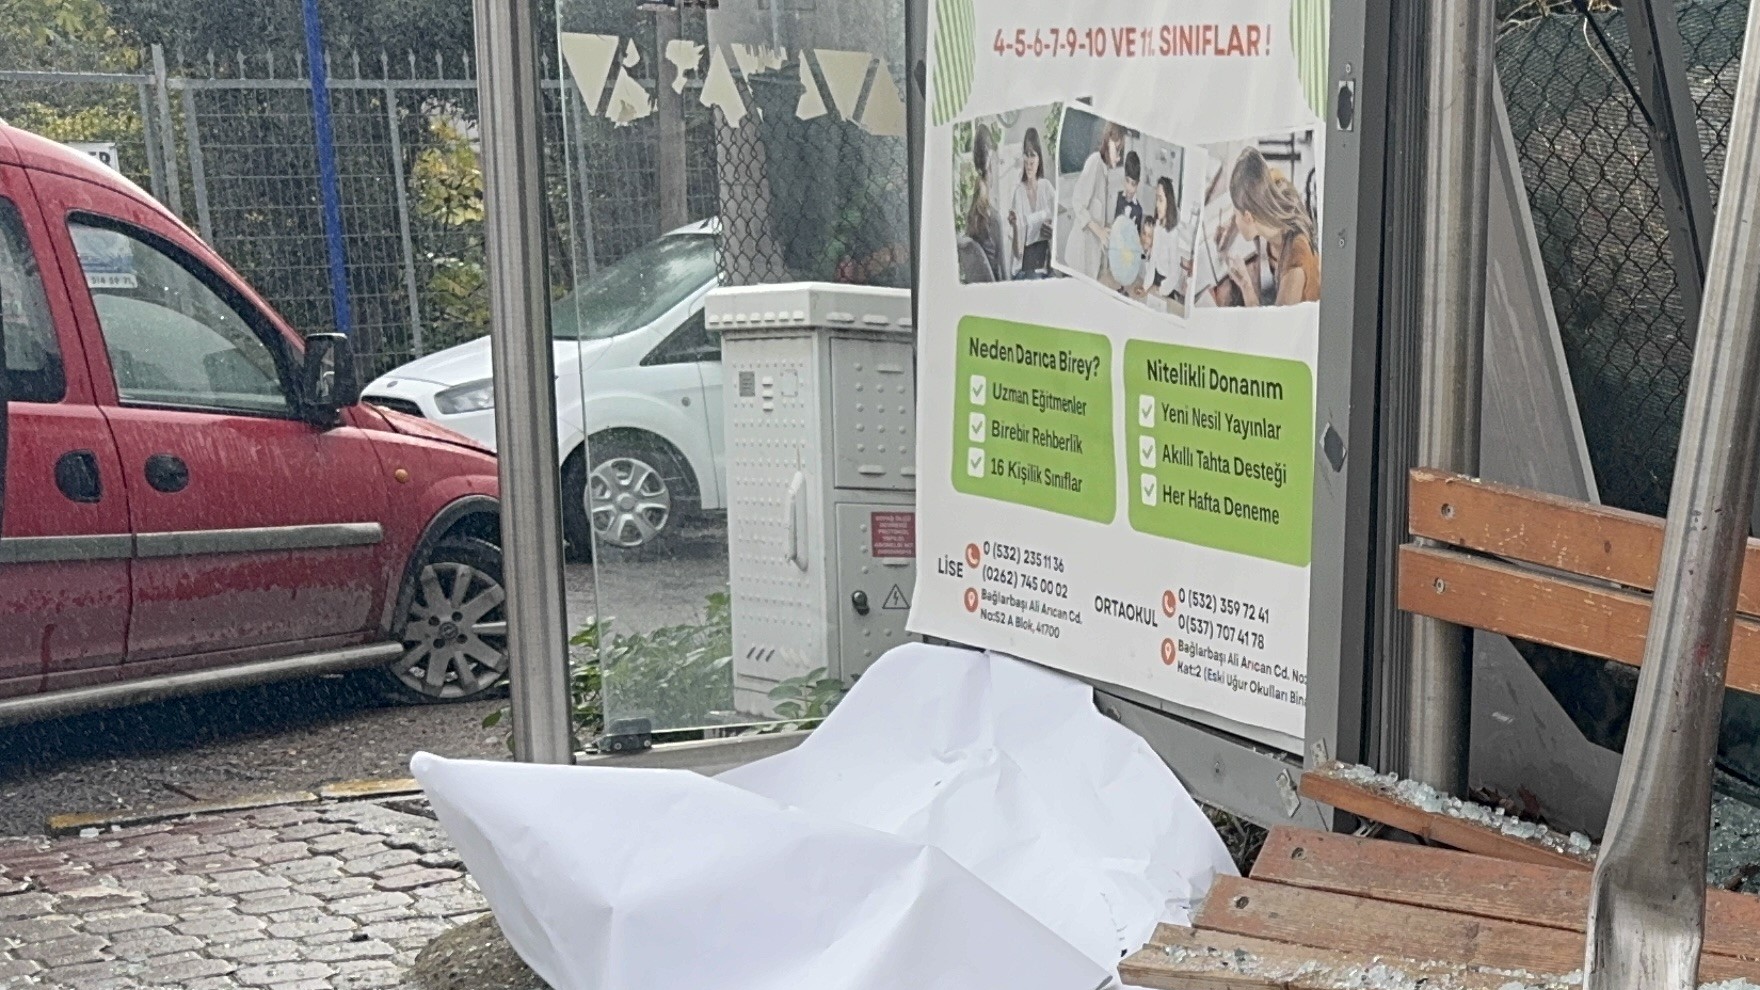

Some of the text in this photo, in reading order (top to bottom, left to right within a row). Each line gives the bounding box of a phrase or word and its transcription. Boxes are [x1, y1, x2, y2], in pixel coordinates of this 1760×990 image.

[993, 27, 1107, 57] 4-5-6-7-9-10
[1111, 27, 1136, 57] VE
[1141, 27, 1156, 57] 11.
[969, 337, 1100, 381] Neden Darıca Birey?
[1147, 359, 1283, 400] Nitelikli Donanım
[992, 382, 1087, 417] Uzman Eğitmenler
[991, 420, 1083, 455] Birebir Rehberlik
[1161, 402, 1282, 440] Yeni Nesil Yayınlar
[991, 457, 1082, 493] 16 Kişilik Sınıflar
[1162, 444, 1287, 488] Akıllı Tahta Desteği
[1163, 484, 1280, 525] Her Hafta Deneme
[938, 554, 964, 579] LİSE
[983, 541, 990, 555] 0
[993, 542, 1020, 565] (532)
[1024, 549, 1042, 567] 235
[1053, 556, 1064, 573] 36
[982, 564, 1068, 599] (0262) 745 00 02
[981, 588, 1027, 613] Bağlarbaşı
[1029, 599, 1040, 613] Ali
[1069, 610, 1083, 625] Cd.
[1007, 614, 1014, 627] A
[1094, 595, 1158, 628] ORTAOKUL
[1178, 588, 1269, 624] 0 (532) 359 72 41
[1216, 623, 1236, 642] 707
[1237, 628, 1249, 646] 41
[1251, 632, 1265, 650] 78
[1178, 639, 1226, 666] Bağlarbaşı
[1227, 652, 1239, 667] Ali
[1274, 664, 1290, 681] Cd.
[1204, 666, 1225, 684] (Eski
[1226, 673, 1249, 692] Uğur
[1250, 680, 1288, 702] Okulları
